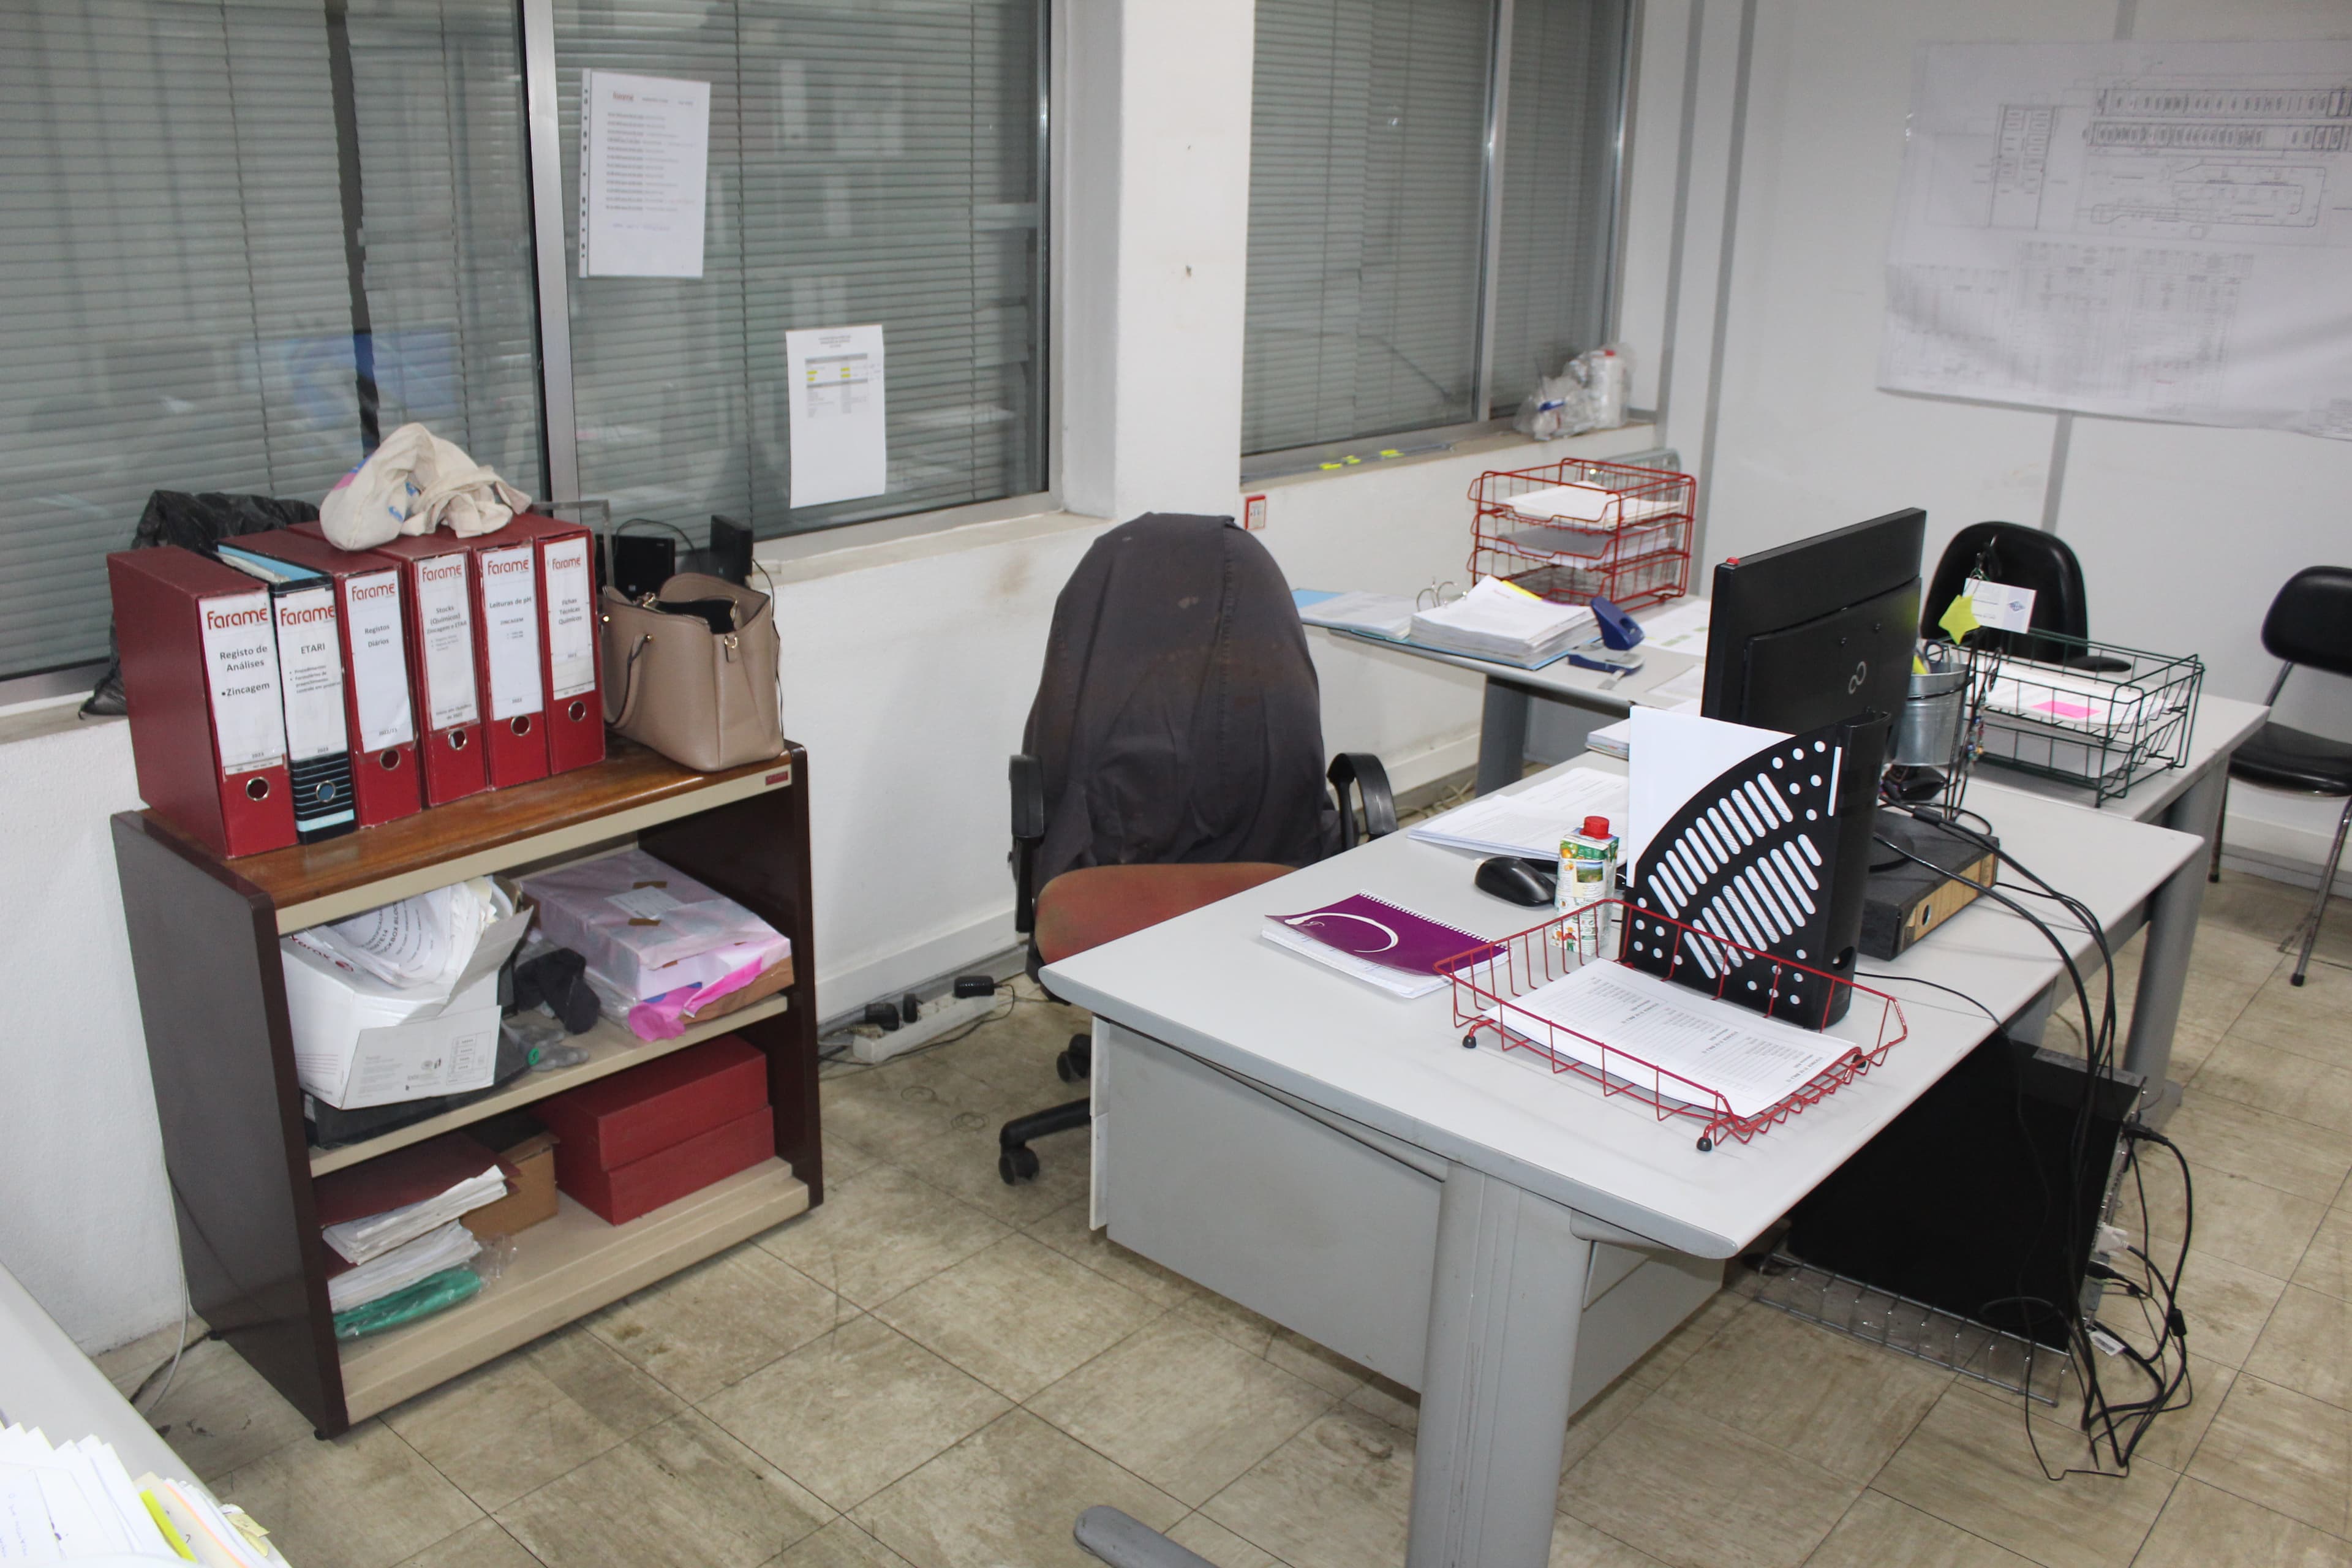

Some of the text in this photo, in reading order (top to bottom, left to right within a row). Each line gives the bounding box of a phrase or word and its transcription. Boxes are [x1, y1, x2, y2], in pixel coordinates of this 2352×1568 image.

[364, 625, 390, 635] Registos
[219, 644, 268, 661] Registo de
[301, 643, 326, 655] ETARI
[226, 659, 265, 673] Análises
[227, 682, 271, 696] Zincagem
